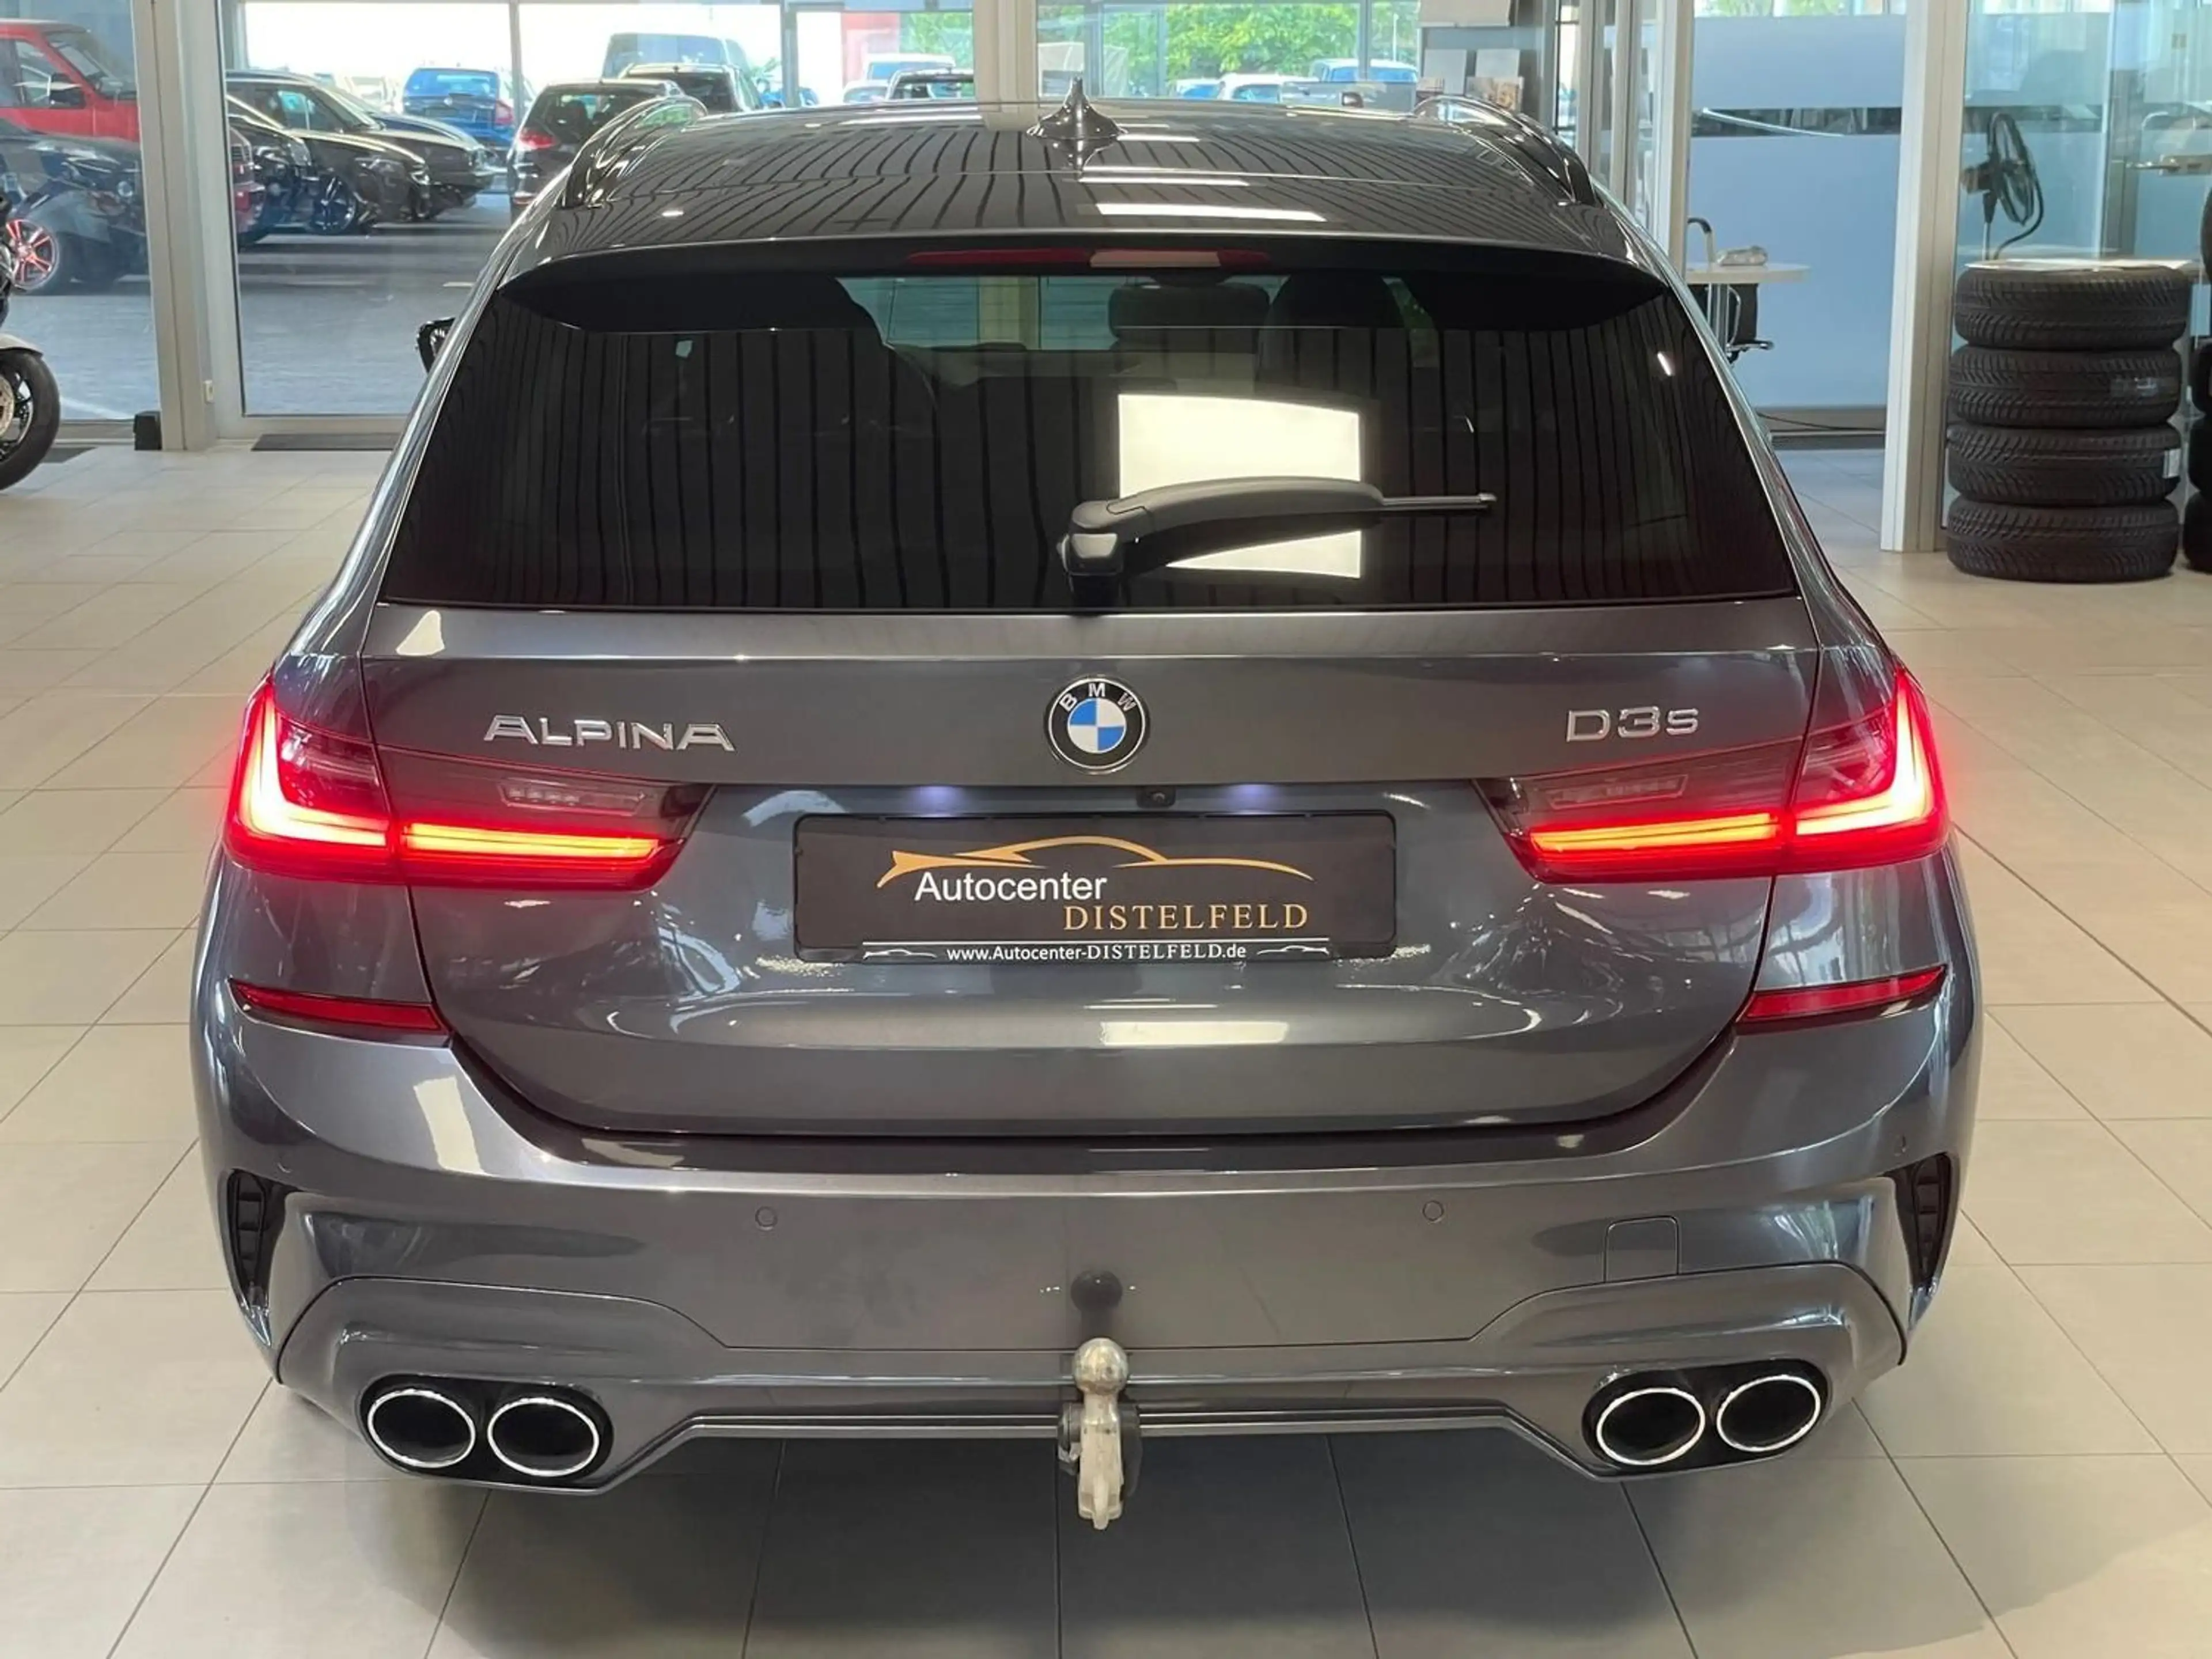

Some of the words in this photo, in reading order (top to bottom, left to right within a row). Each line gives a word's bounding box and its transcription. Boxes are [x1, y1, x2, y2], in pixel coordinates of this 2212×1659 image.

[1059, 683, 1137, 712] BMW
[484, 714, 735, 751] ALPINA
[914, 871, 1107, 901] Autocenter
[1063, 904, 1308, 930] DISTELFELD
[946, 944, 1247, 960] www.Autocenter-DISTELFELD.de
